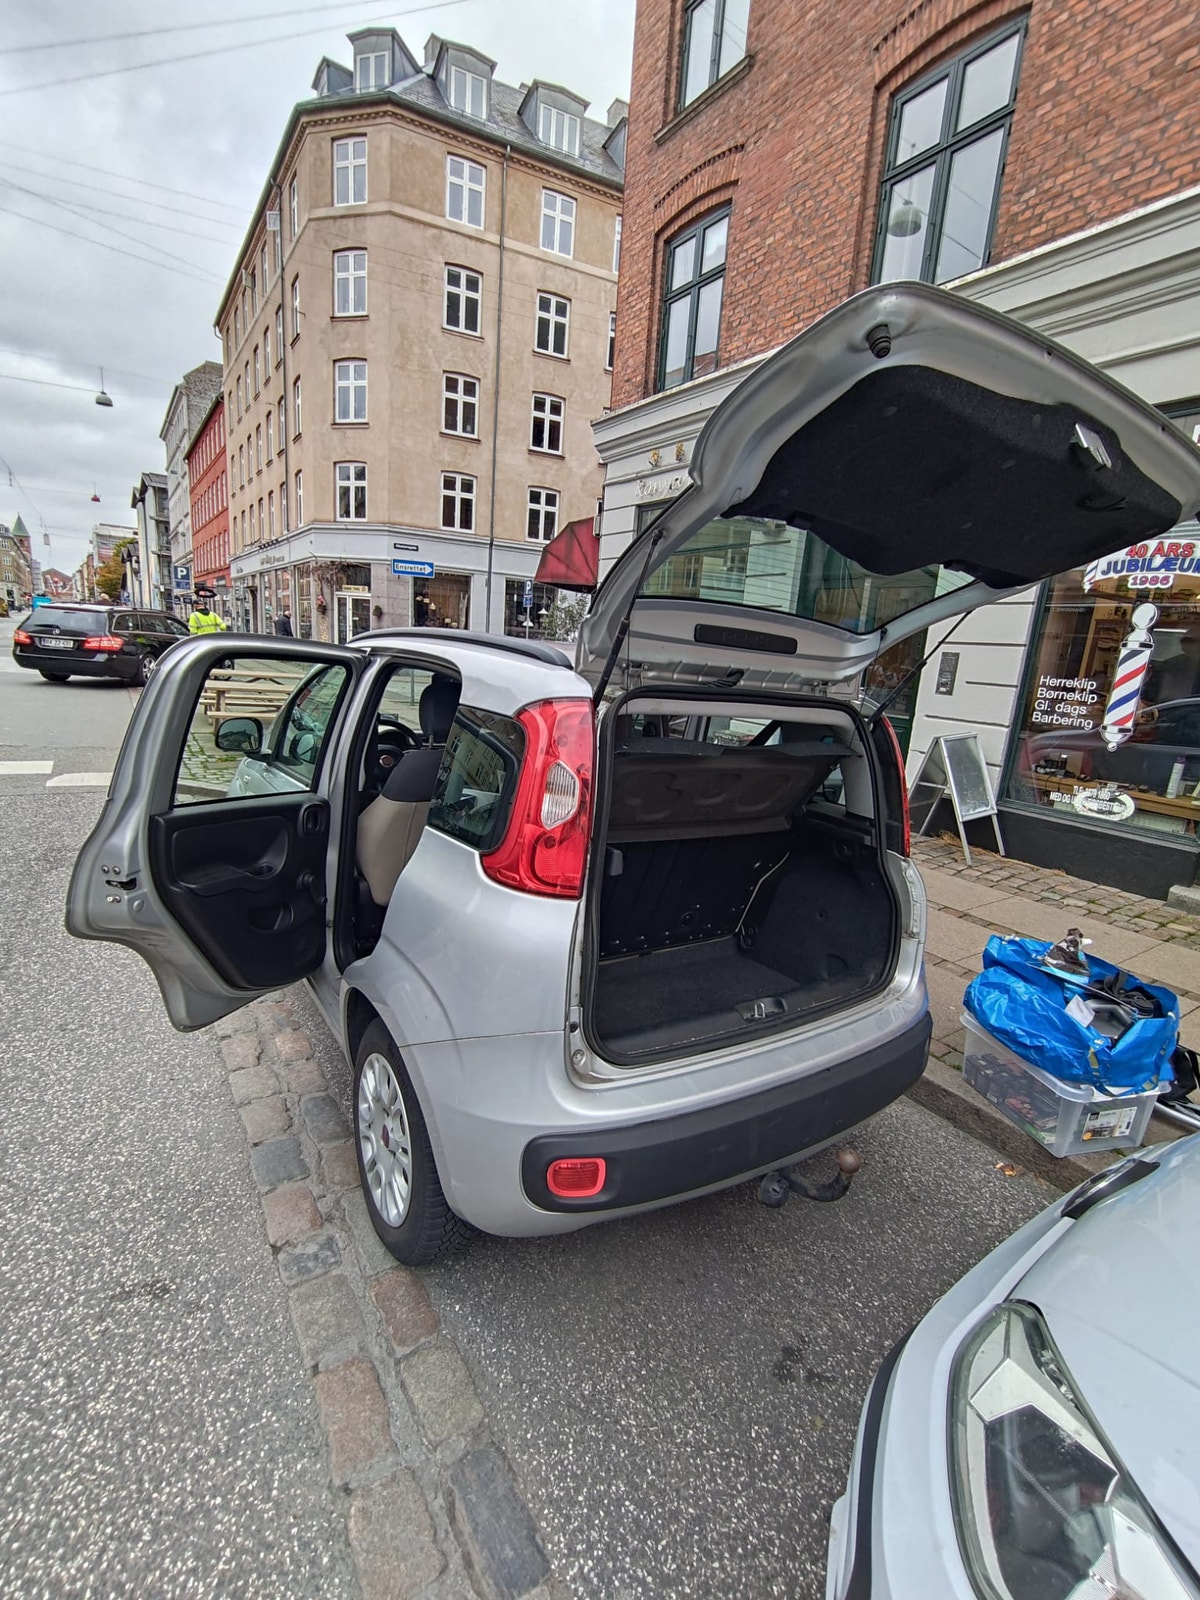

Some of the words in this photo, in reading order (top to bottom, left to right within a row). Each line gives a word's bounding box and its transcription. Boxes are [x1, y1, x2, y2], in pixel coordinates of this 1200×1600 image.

[1126, 544, 1148, 558] 40
[177, 567, 187, 579] P
[395, 563, 426, 573] Ensrettet
[526, 580, 532, 595] P
[1131, 575, 1171, 586] 1986
[1040, 675, 1097, 691] Herreklip
[1037, 687, 1098, 704] Børneklip
[1034, 699, 1051, 711] Gl.
[1055, 702, 1087, 716] dags
[1032, 711, 1093, 731] Barbering
[1049, 791, 1062, 801] MED
[1062, 794, 1072, 804] OG
